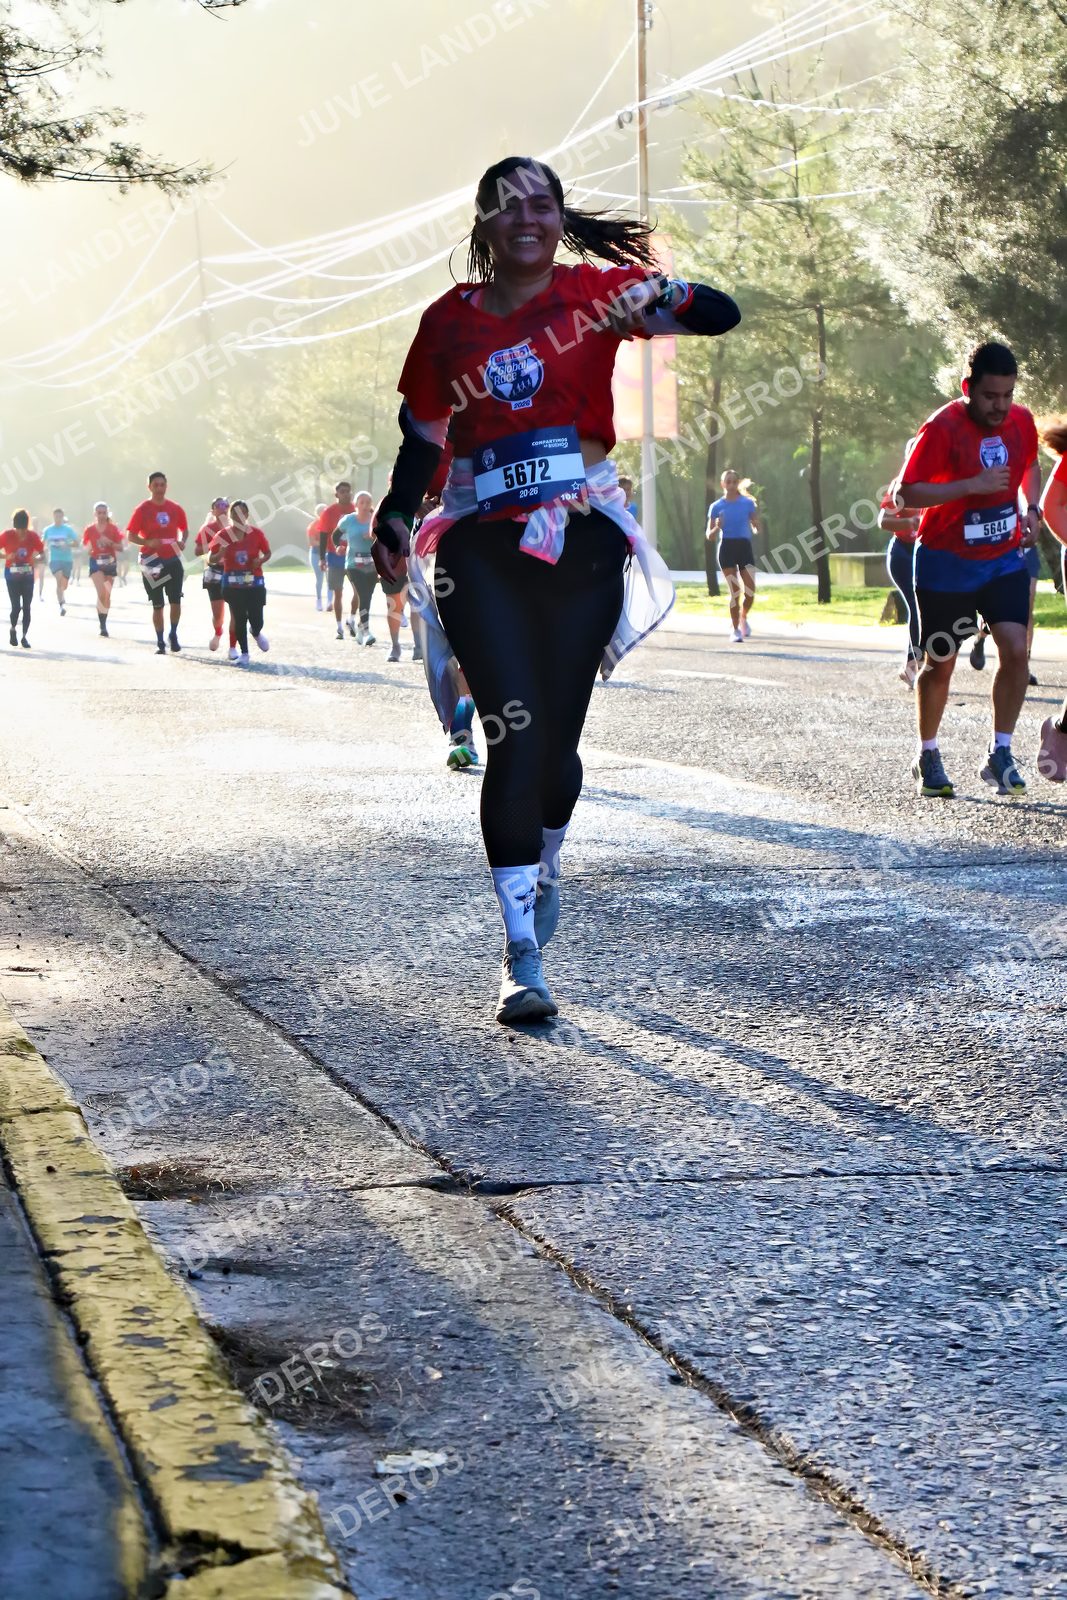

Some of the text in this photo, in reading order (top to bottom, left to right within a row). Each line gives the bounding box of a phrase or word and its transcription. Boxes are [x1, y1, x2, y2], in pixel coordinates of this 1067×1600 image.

[494, 371, 517, 386] Race
[502, 458, 551, 489] 5672
[983, 520, 1008, 536] 5644
